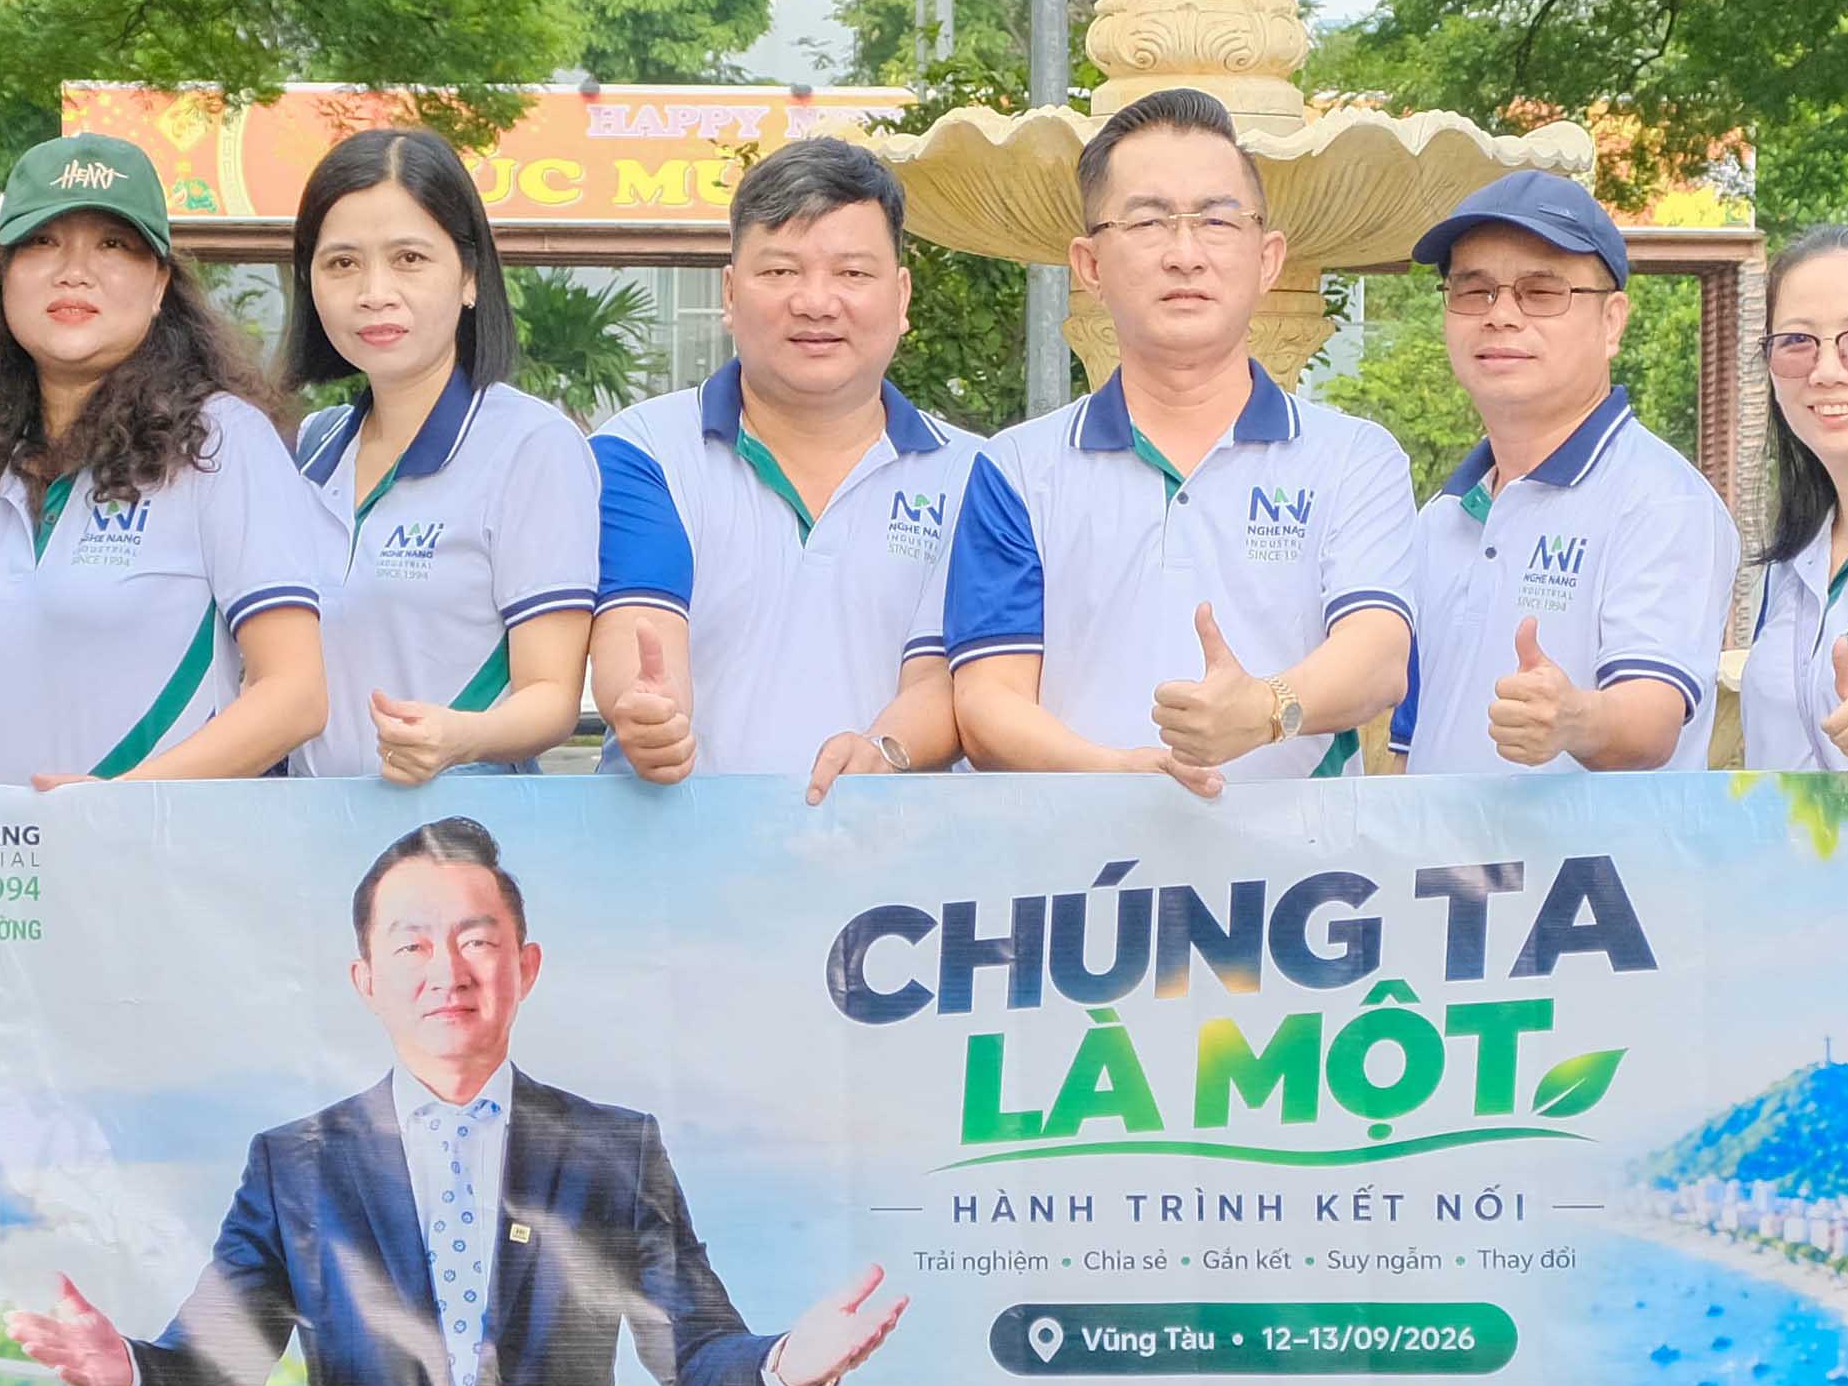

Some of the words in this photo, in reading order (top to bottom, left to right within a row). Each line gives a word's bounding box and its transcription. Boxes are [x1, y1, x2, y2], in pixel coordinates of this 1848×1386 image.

[587, 104, 770, 139] HAPPY
[826, 859, 1382, 1025] CHÚNG
[1415, 854, 1659, 982] TA
[961, 1007, 1164, 1145] LÀ
[1194, 980, 1554, 1141] MỘT
[953, 1189, 1093, 1223] HÀNH
[1125, 1187, 1282, 1222] TRÌNH
[1316, 1184, 1404, 1222] KẾT
[1437, 1184, 1524, 1221] NỐI
[913, 1250, 955, 1271] Trải
[962, 1250, 1049, 1276] nghiệm
[1083, 1249, 1135, 1271] Chia
[1142, 1248, 1168, 1270] sẻ
[1256, 1247, 1292, 1270] kết
[1327, 1249, 1370, 1274] Suy
[1376, 1246, 1442, 1275] ngẫm
[1477, 1249, 1534, 1274] Thay
[1540, 1246, 1576, 1269] đổi
[1081, 1327, 1157, 1357] Vũng
[1163, 1326, 1215, 1351] Tàu
